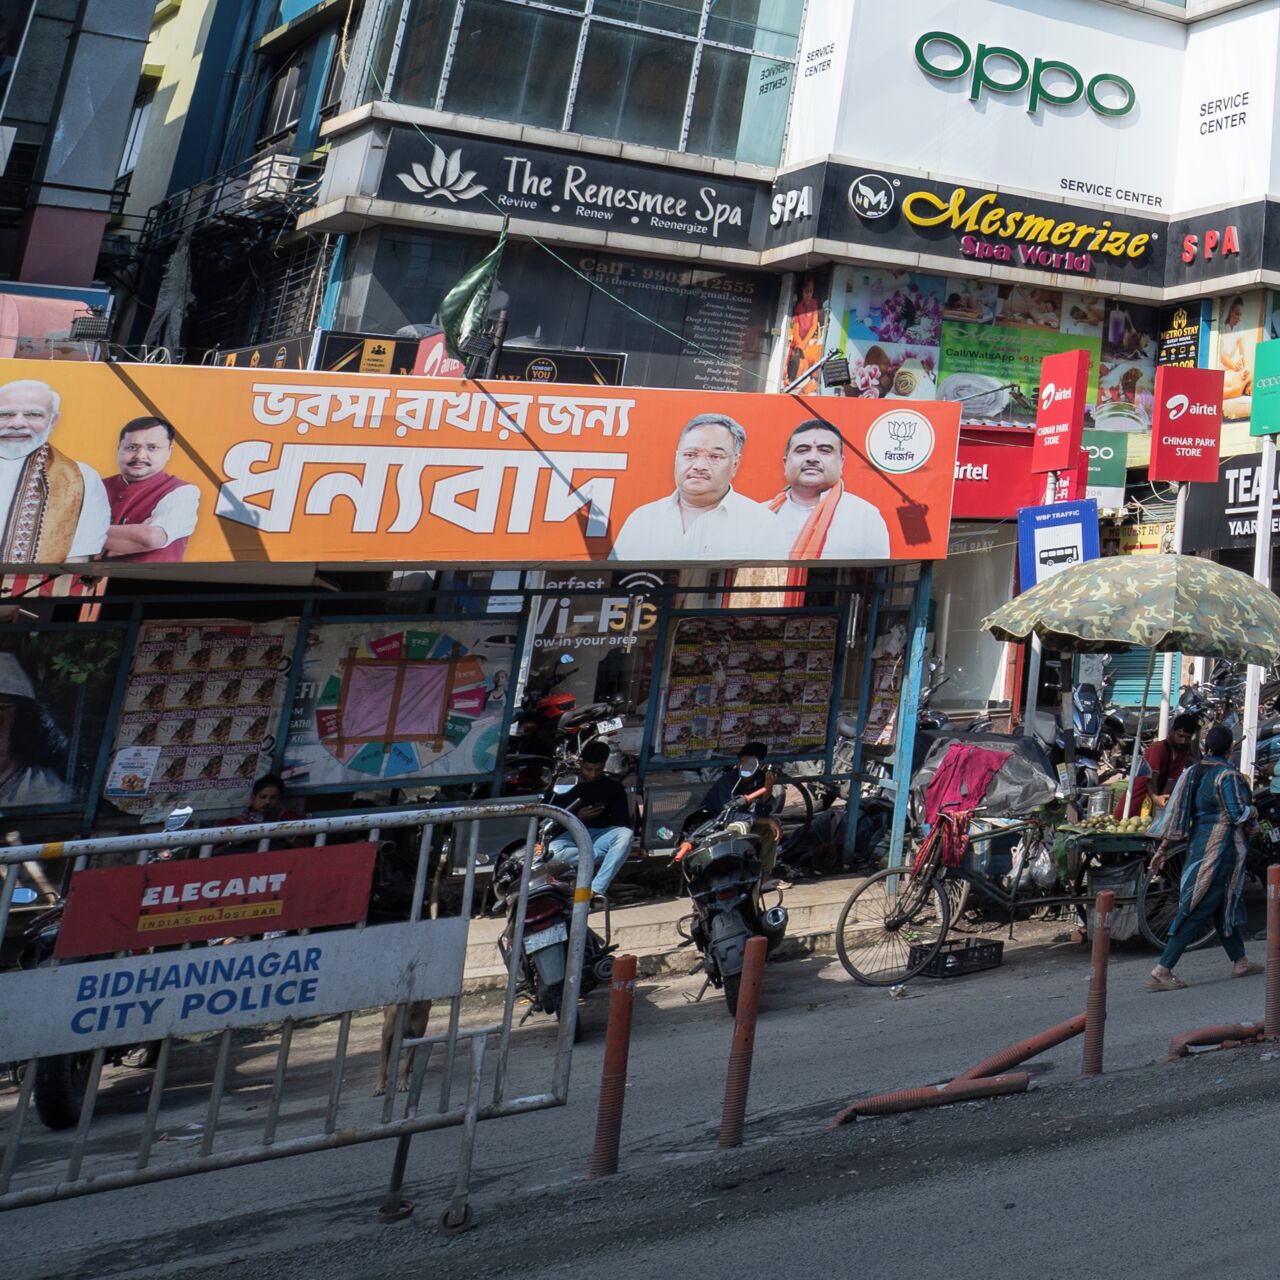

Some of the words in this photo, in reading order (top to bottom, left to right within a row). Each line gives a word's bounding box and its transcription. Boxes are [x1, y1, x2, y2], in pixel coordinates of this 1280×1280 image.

[806, 42, 835, 63] SERVICE
[804, 59, 832, 78] CENTER
[914, 30, 1136, 117] oppo
[1199, 91, 1250, 117] SERVICE
[1199, 111, 1247, 136] CENTER
[502, 156, 553, 197] The
[563, 164, 688, 217] Renesmee
[694, 186, 743, 238] Spa
[1059, 178, 1113, 198] SERVICE
[1115, 189, 1163, 208] CENTER
[497, 194, 538, 210] Revive
[575, 205, 614, 220] Renew
[650, 216, 709, 235] Reenergize
[769, 185, 814, 228] SPA
[902, 187, 1151, 259] Mesmerize
[959, 234, 1011, 263] Spa
[1017, 243, 1092, 272] World
[1181, 224, 1240, 265] SPA
[579, 257, 624, 275] Call
[1160, 327, 1183, 340] METRO
[1183, 325, 1199, 336] STAY
[440, 354, 461, 375] airtel
[693, 358, 715, 368] Couple
[945, 348, 1015, 363] Call/WatsApp
[532, 370, 551, 380] YOU
[694, 374, 709, 384] Body
[709, 376, 739, 386] Polishing
[706, 367, 722, 377] Body
[1054, 387, 1073, 402] airtel
[252, 383, 391, 436] ভরসা
[394, 388, 534, 440] রাখার
[538, 395, 637, 438] জন্য
[1190, 403, 1217, 416] airtel
[1037, 424, 1056, 436] CHINAR
[1056, 423, 1070, 434] PARK
[1043, 435, 1060, 446] STORE
[1162, 436, 1193, 446] CHINAR
[1195, 437, 1216, 447] PARK
[884, 451, 915, 462] বিজেপি
[1176, 447, 1202, 457] STORE
[954, 461, 989, 481] irtel
[214, 439, 630, 539] ধন্যবাদ
[1035, 512, 1052, 522] WBP
[1051, 509, 1081, 520] TRAFFIC
[1228, 515, 1258, 536] YAAR
[608, 602, 658, 630] 5G
[559, 635, 571, 647] in
[574, 636, 605, 649] your
[608, 635, 638, 645] area
[141, 873, 287, 907] ELEGANT
[142, 915, 192, 930] INDIA'S
[252, 907, 277, 916] BAR
[76, 947, 322, 1002] BIDHANNAGAR
[70, 998, 165, 1035] CITY
[180, 978, 319, 1020] POLICE
